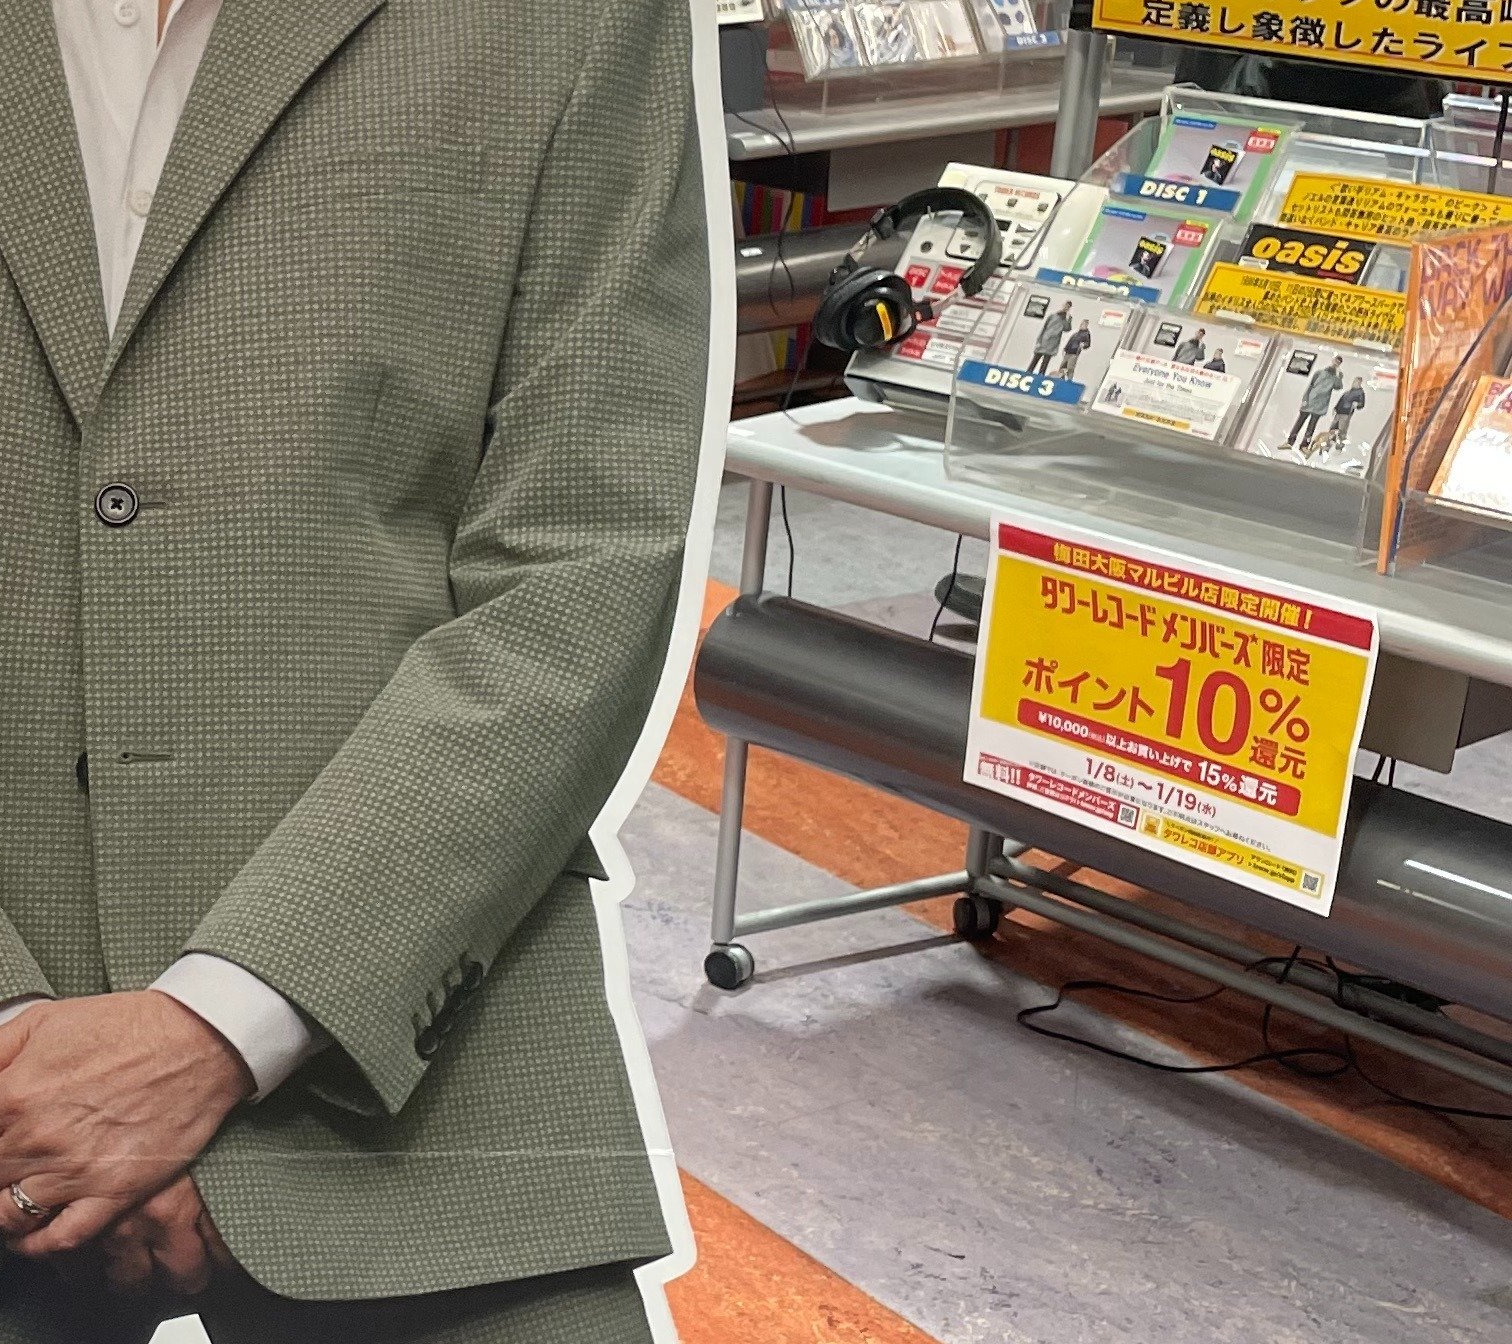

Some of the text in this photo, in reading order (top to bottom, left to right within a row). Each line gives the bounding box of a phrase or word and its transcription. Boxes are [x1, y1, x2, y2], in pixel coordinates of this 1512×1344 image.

[1139, 179, 1208, 205] DISC 1
[1251, 236, 1365, 275] oasis
[985, 367, 1055, 397] DISC 3
[1249, 735, 1307, 780] 還元
